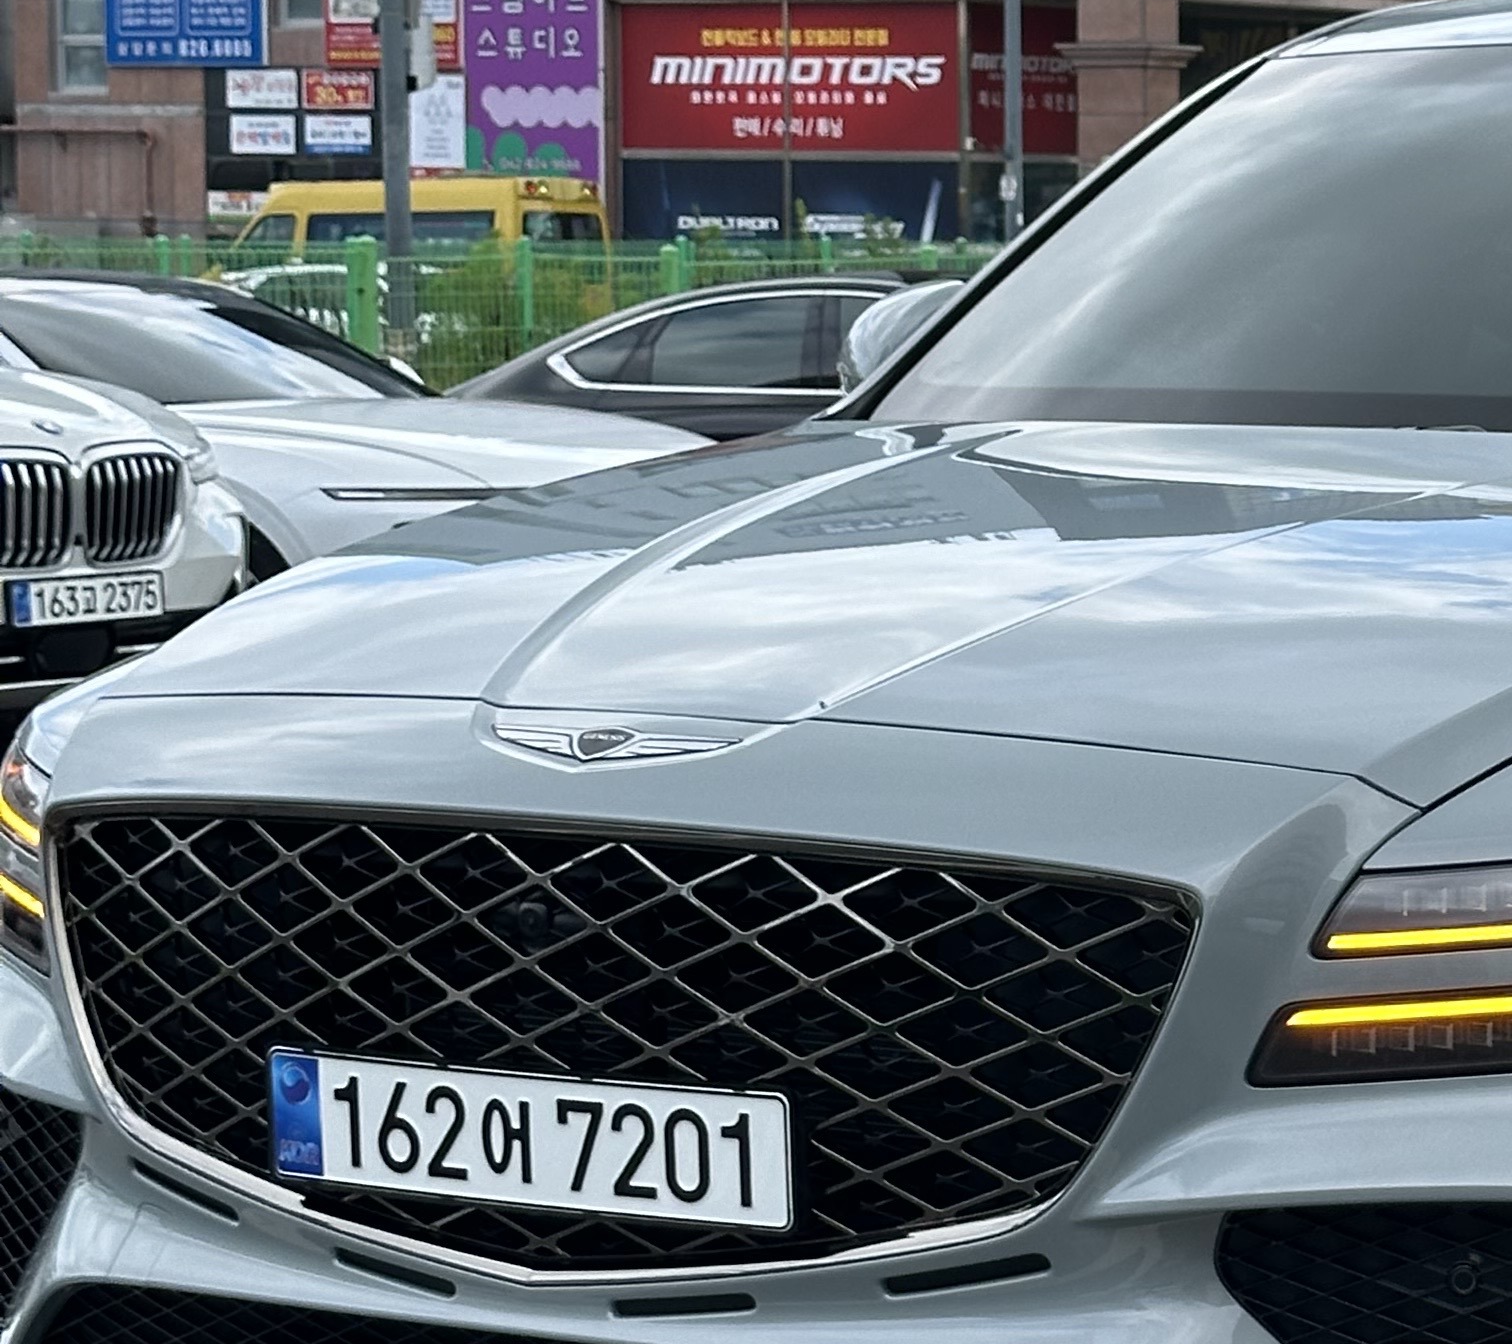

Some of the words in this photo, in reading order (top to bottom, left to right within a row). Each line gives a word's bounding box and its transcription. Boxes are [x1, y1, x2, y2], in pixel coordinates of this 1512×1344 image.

[476, 26, 583, 60] 스튜디오
[103, 579, 158, 614] 2375
[333, 1075, 533, 1185] 162어
[555, 1097, 753, 1209] 7201
